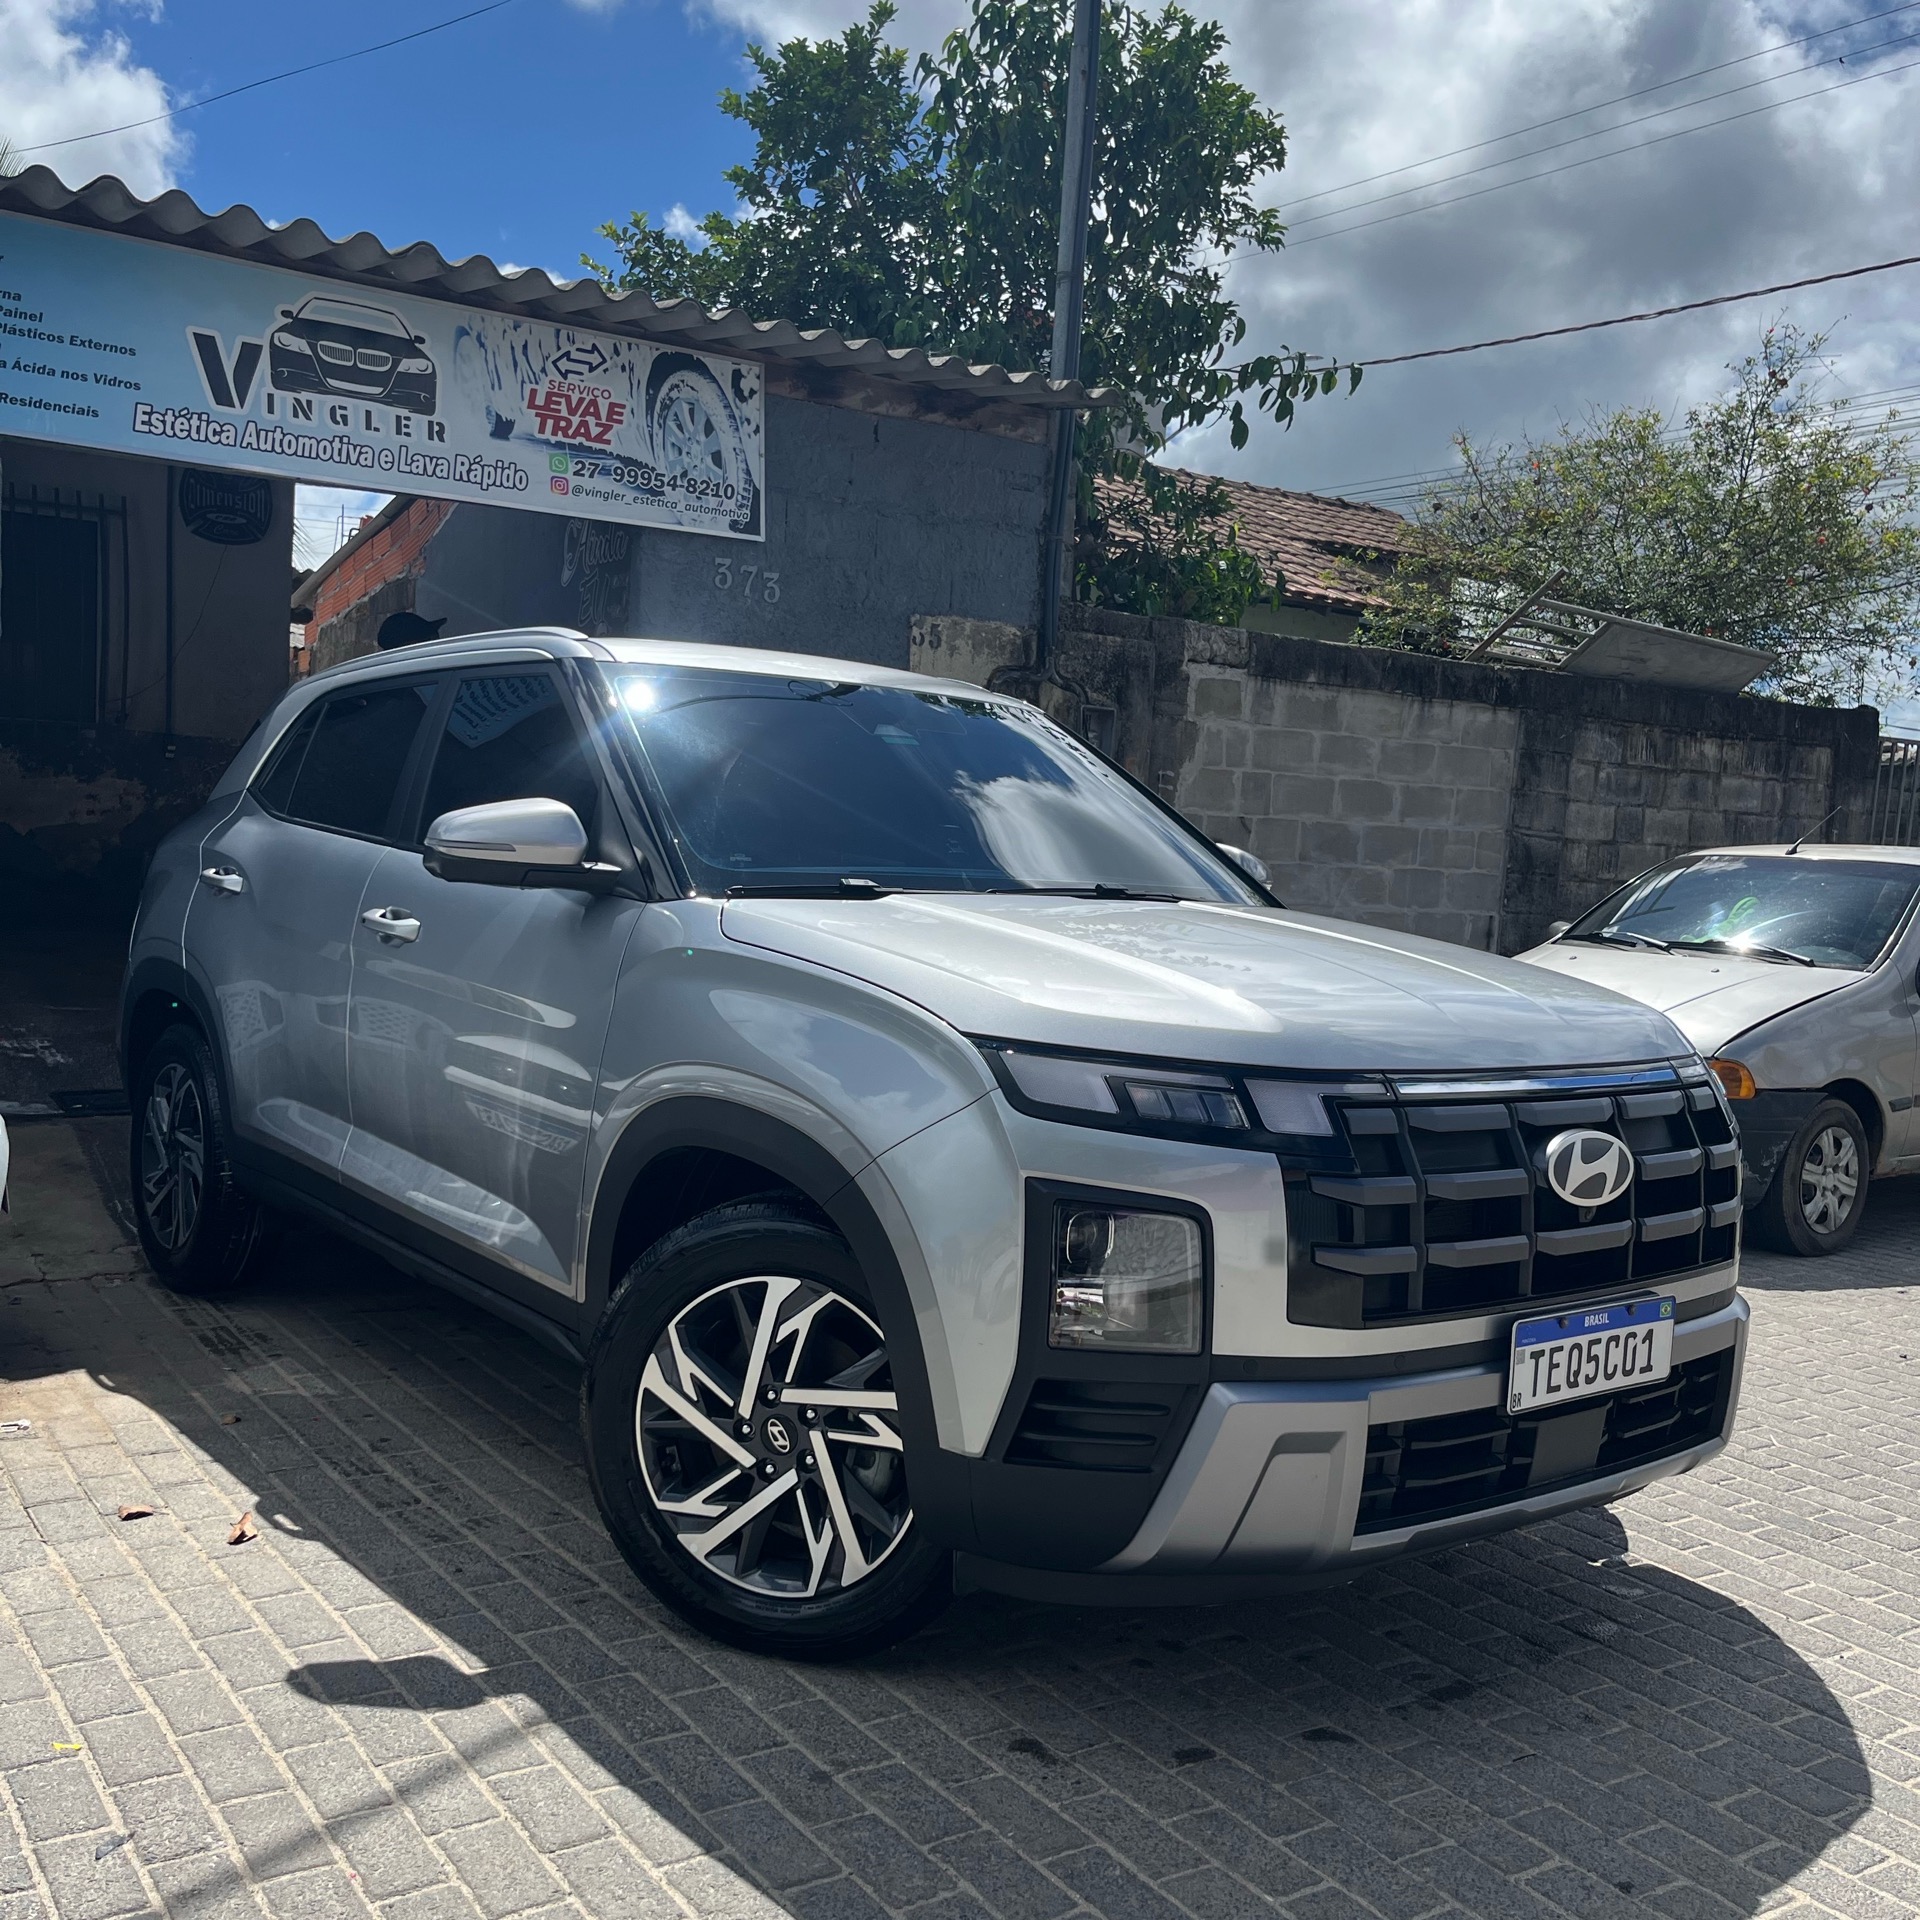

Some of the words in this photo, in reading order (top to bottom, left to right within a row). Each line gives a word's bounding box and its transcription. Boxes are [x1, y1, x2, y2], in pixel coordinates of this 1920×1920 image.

[69, 335, 137, 357] Externos
[11, 357, 56, 377] Ácida
[61, 369, 88, 382] nos
[94, 373, 141, 391] Vidros
[192, 331, 446, 443] VINGLER
[527, 388, 603, 423] LEVA
[606, 402, 627, 425] E
[133, 402, 237, 447] Estética
[240, 420, 375, 468] Automotiva
[378, 447, 395, 471] e
[397, 445, 450, 480] Lava
[454, 453, 529, 491] Rápido
[535, 412, 614, 446] TRAZ
[572, 460, 600, 479] 27
[612, 466, 736, 500] 99954-8210
[571, 484, 749, 521] @vingler_estetica_automotiva
[714, 557, 780, 605] 373
[1584, 1312, 1609, 1327] BRASIL
[1529, 1328, 1654, 1398] TEQ5C01
[1512, 1392, 1522, 1409] BR
